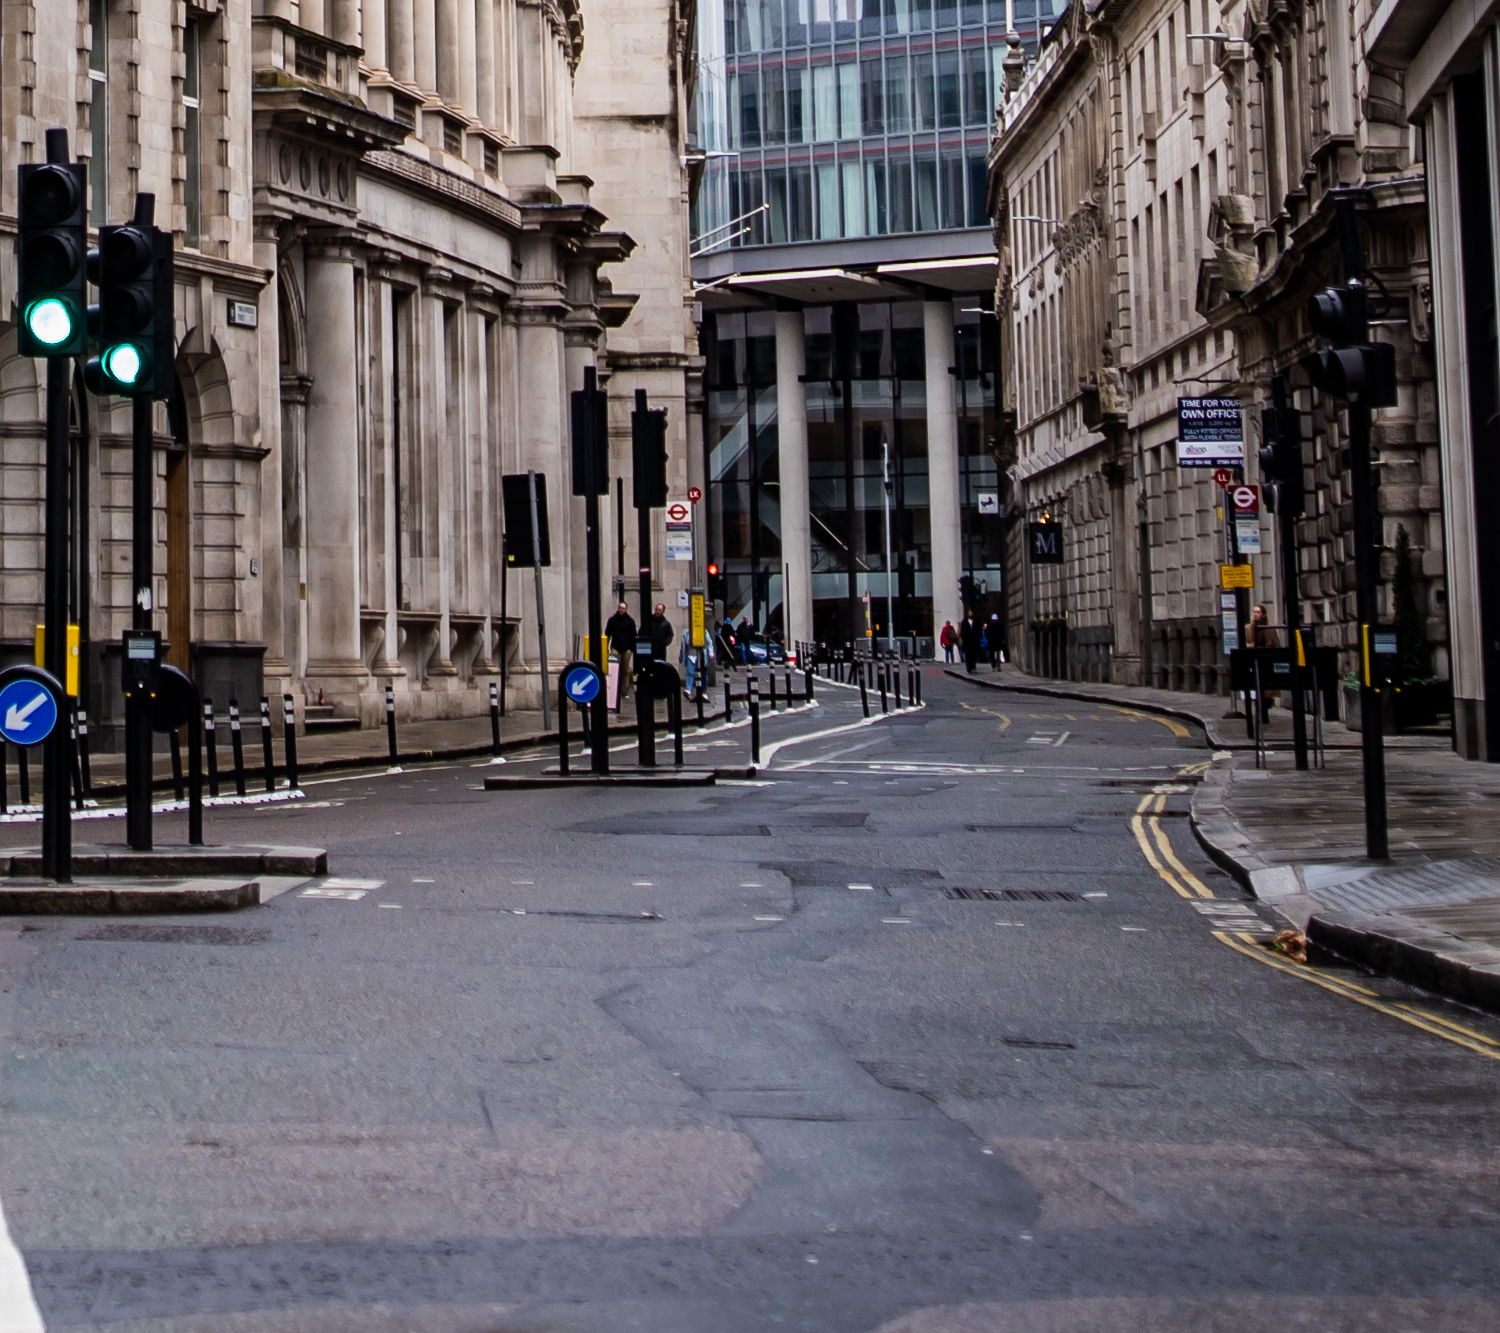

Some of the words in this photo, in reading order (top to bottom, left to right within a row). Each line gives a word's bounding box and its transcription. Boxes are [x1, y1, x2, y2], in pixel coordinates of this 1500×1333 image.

[1181, 399, 1201, 408] TIME
[1202, 399, 1218, 407] FOR
[1181, 409, 1205, 419] OWN
[1217, 473, 1228, 482] LL
[689, 490, 700, 499] LK
[1036, 532, 1057, 555] M
